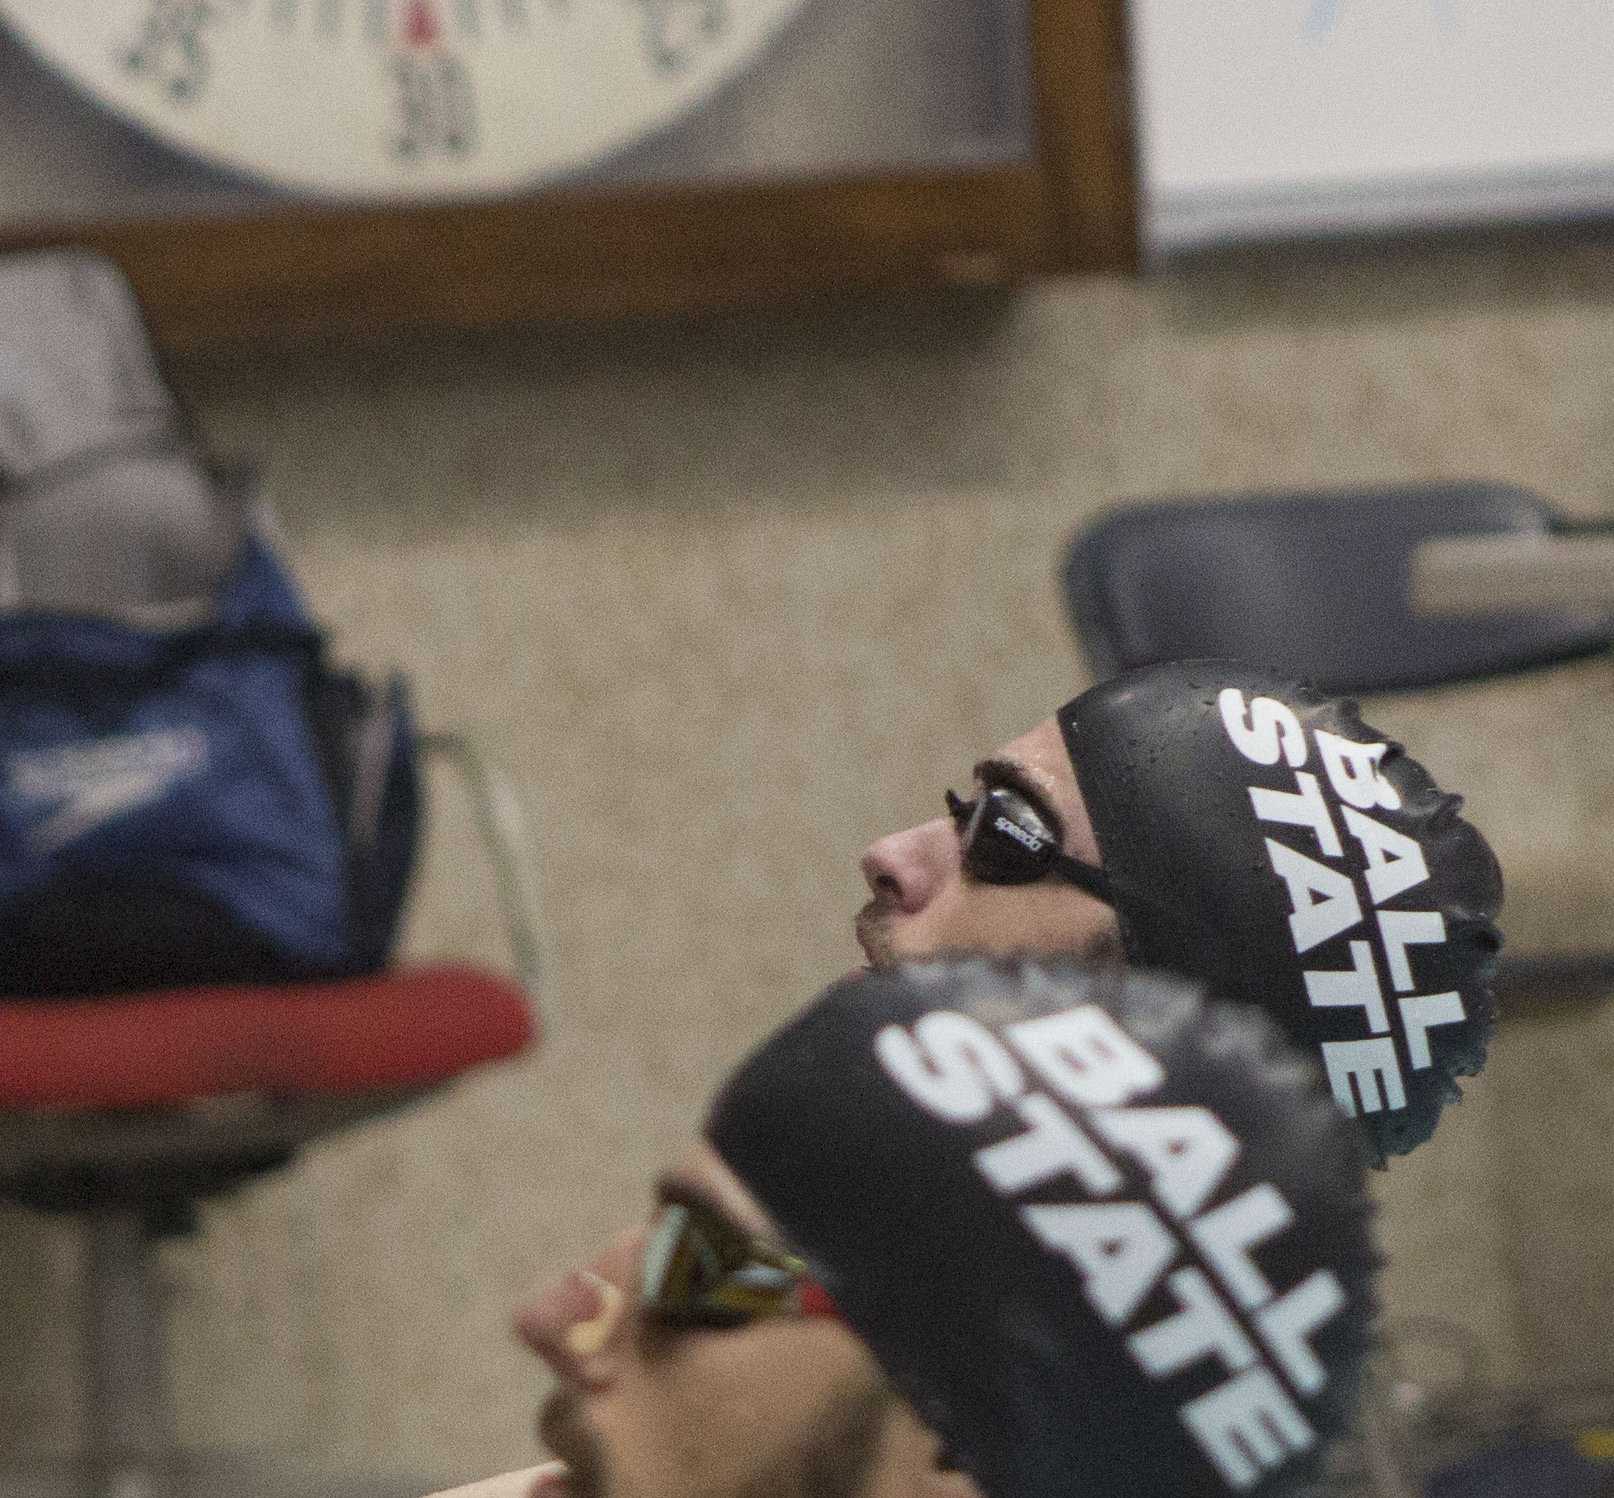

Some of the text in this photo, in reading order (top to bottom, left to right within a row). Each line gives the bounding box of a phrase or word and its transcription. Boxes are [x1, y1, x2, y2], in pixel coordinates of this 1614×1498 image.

[994, 816, 1043, 852] speedo
[1219, 688, 1407, 1118] STATE
[1313, 728, 1467, 1070] BALL
[874, 1009, 1319, 1491] STATE
[1004, 1003, 1349, 1397] BALL
